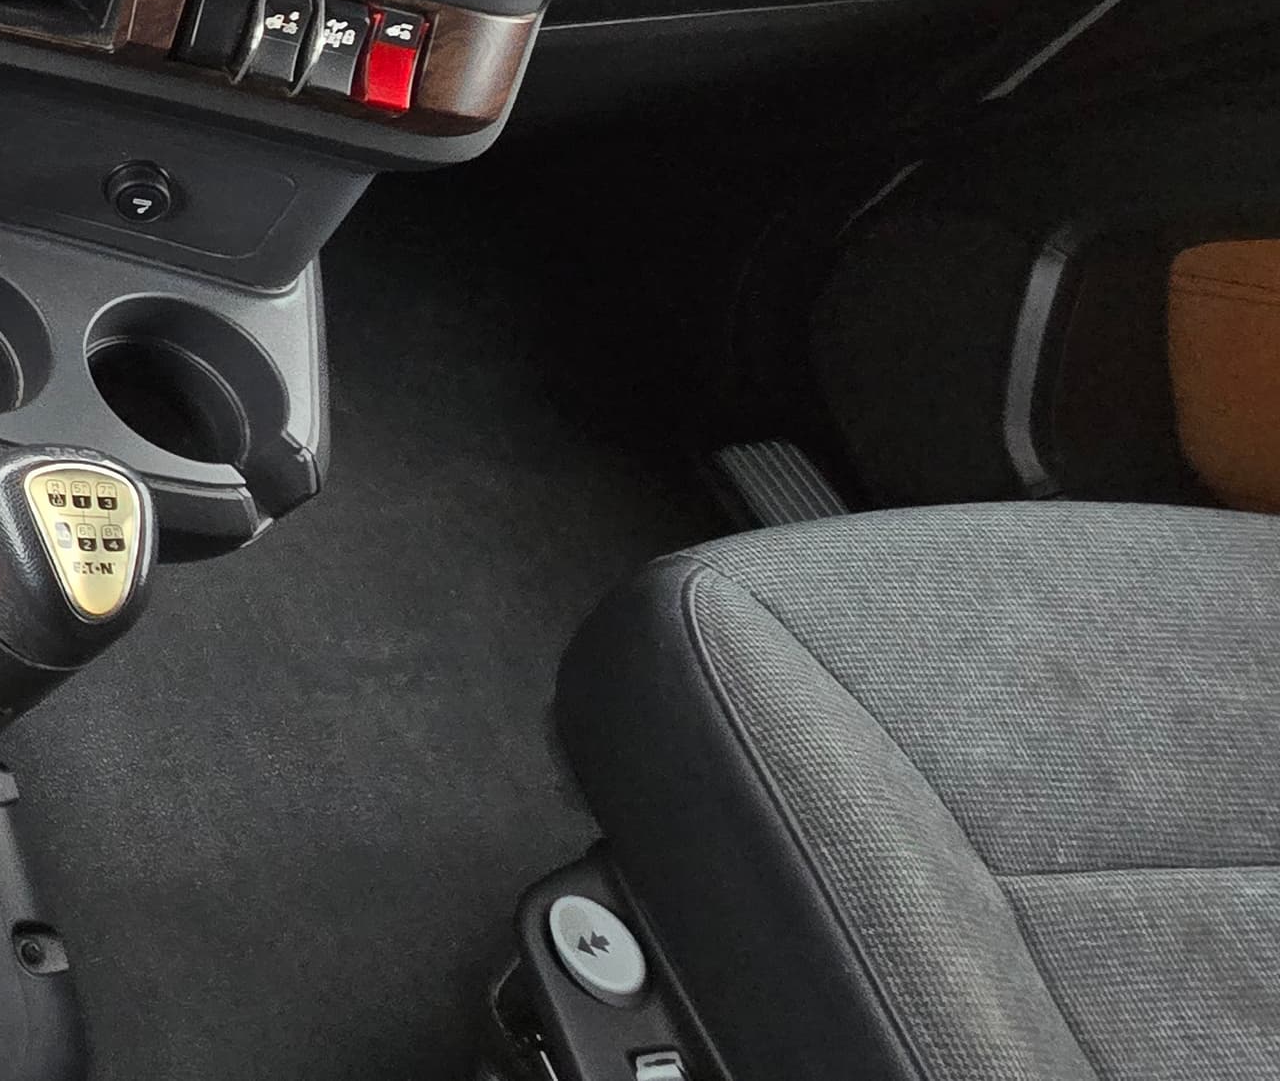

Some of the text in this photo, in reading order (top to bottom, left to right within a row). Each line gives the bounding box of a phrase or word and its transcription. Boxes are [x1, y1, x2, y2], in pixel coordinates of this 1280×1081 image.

[79, 497, 85, 507] 1
[104, 499, 113, 509] 3
[83, 540, 92, 550] 2
[109, 541, 119, 550] 4
